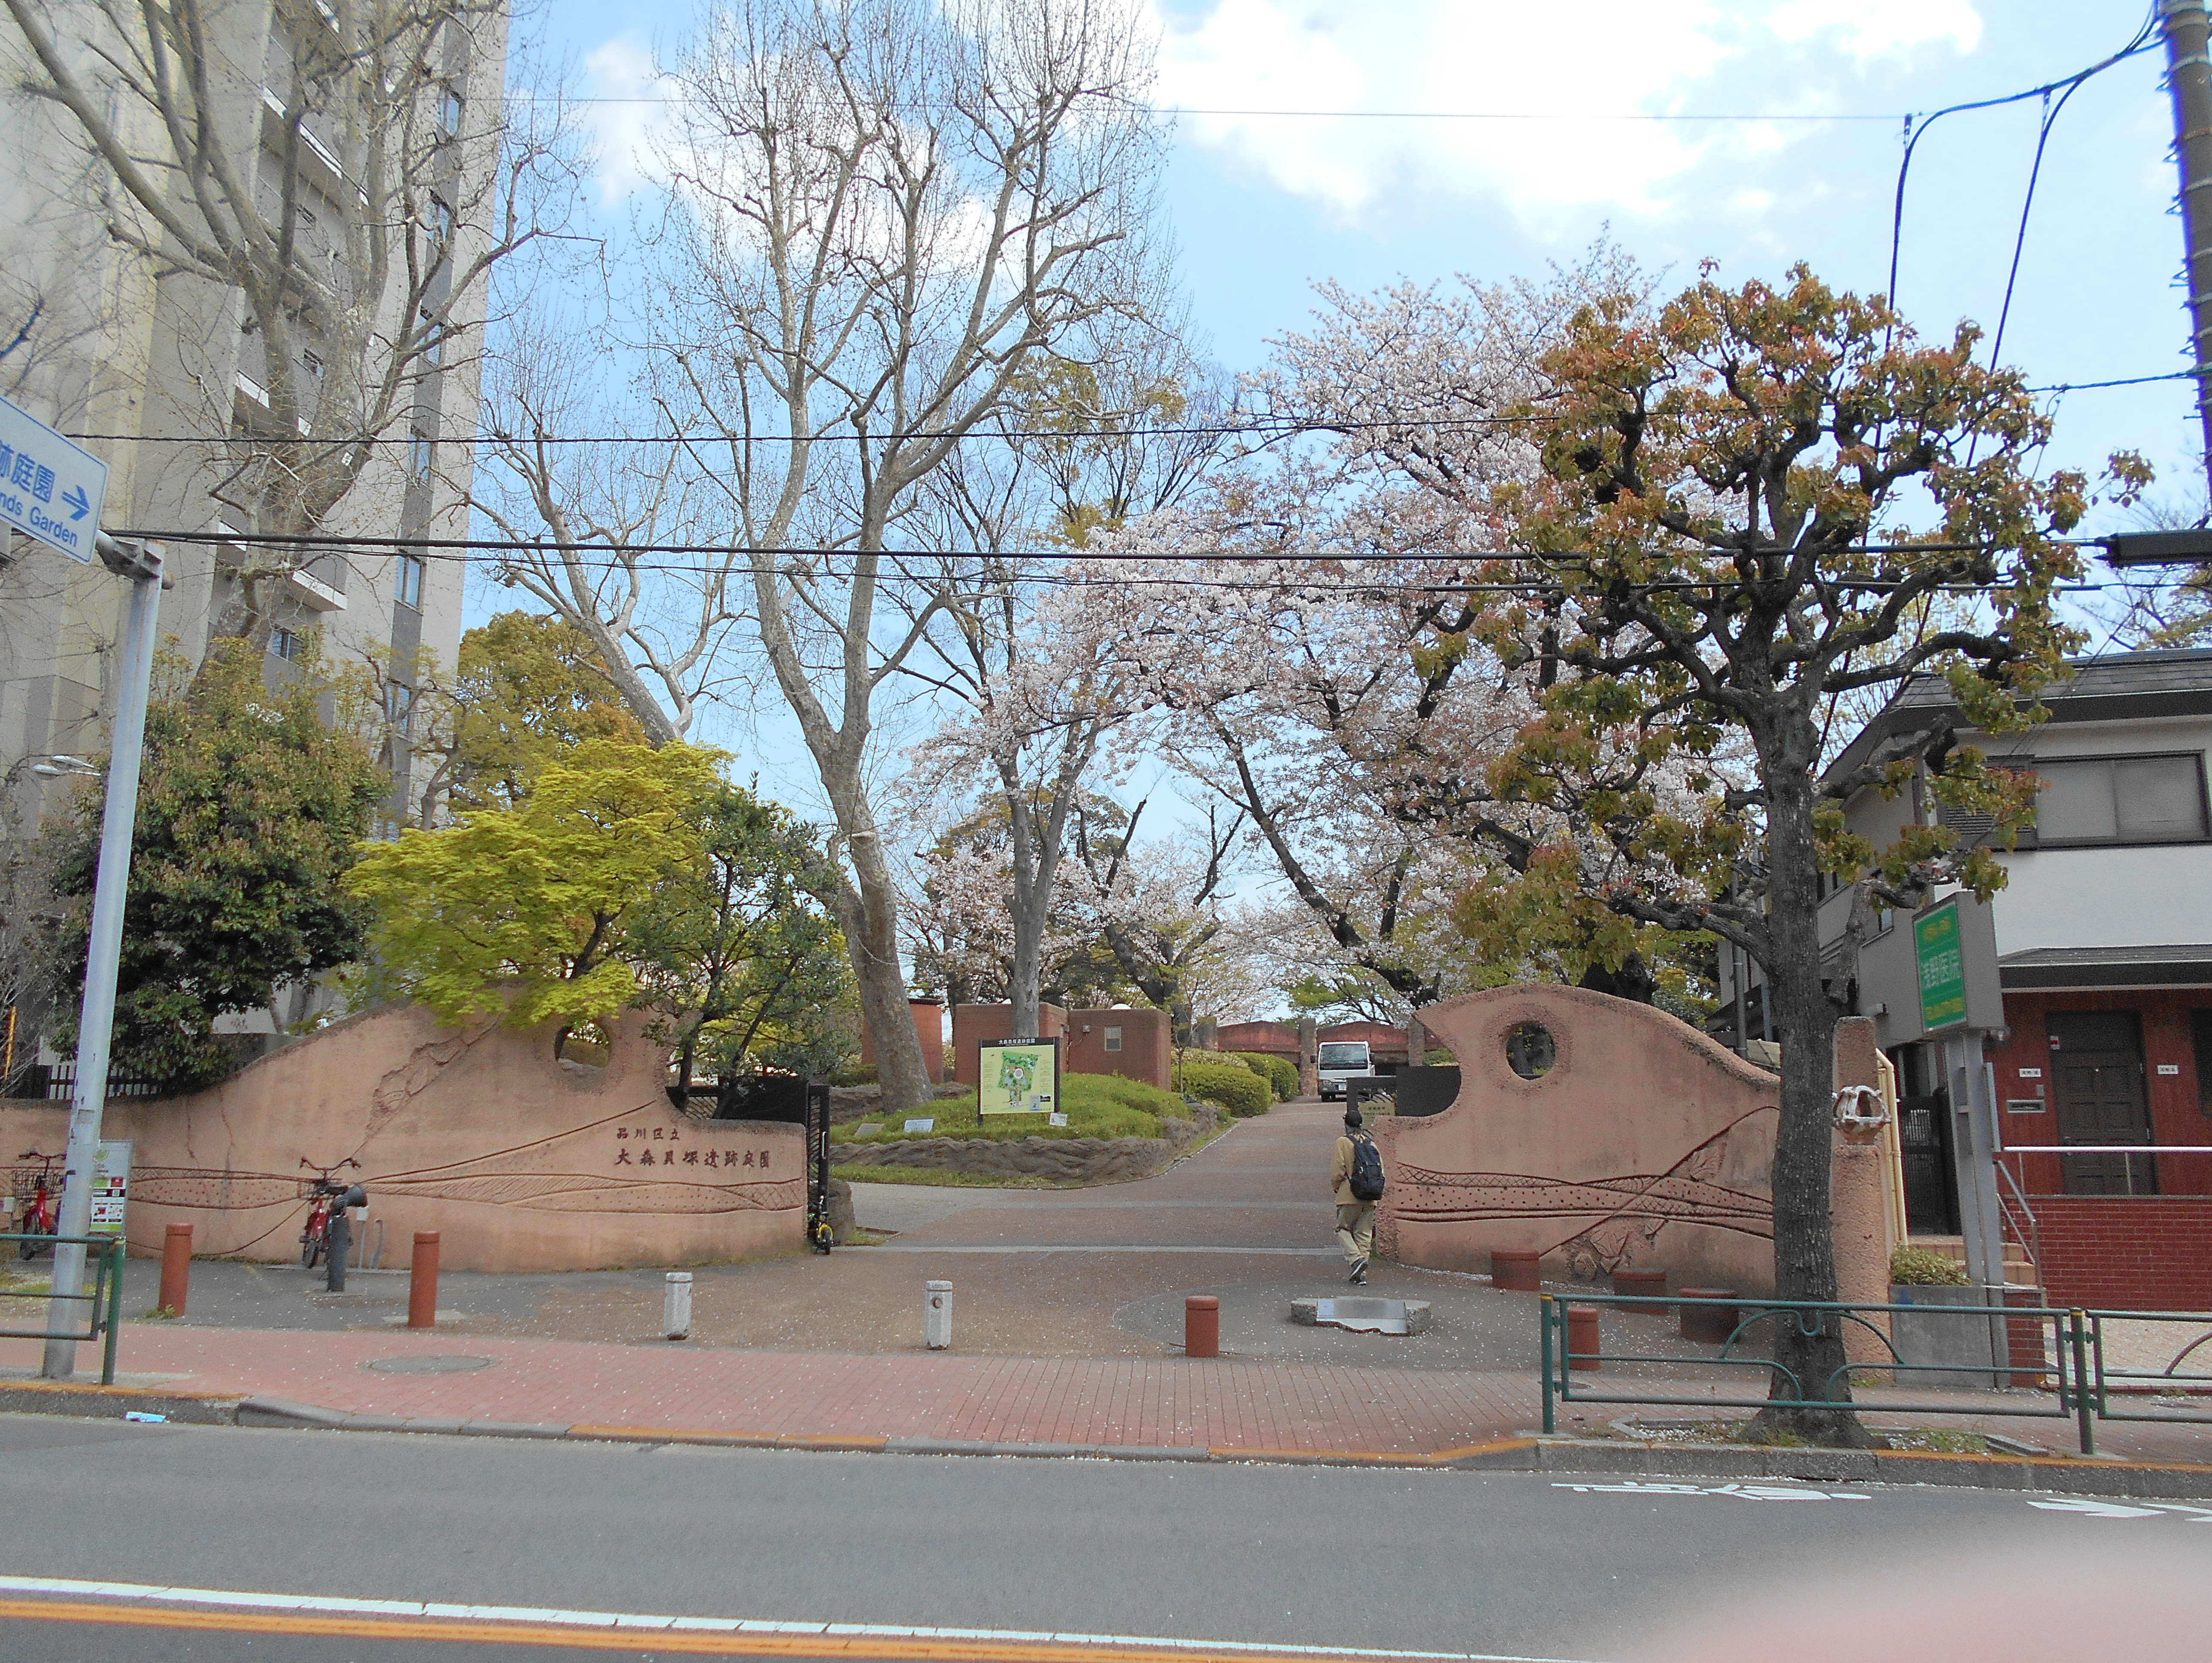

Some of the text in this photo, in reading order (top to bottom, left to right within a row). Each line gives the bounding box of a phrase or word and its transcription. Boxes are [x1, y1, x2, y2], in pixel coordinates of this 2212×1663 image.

[30, 506, 78, 547] Garden
[617, 1128, 680, 1140] 品川区立
[614, 1148, 769, 1168] 大森貝塚遺跡庭園
